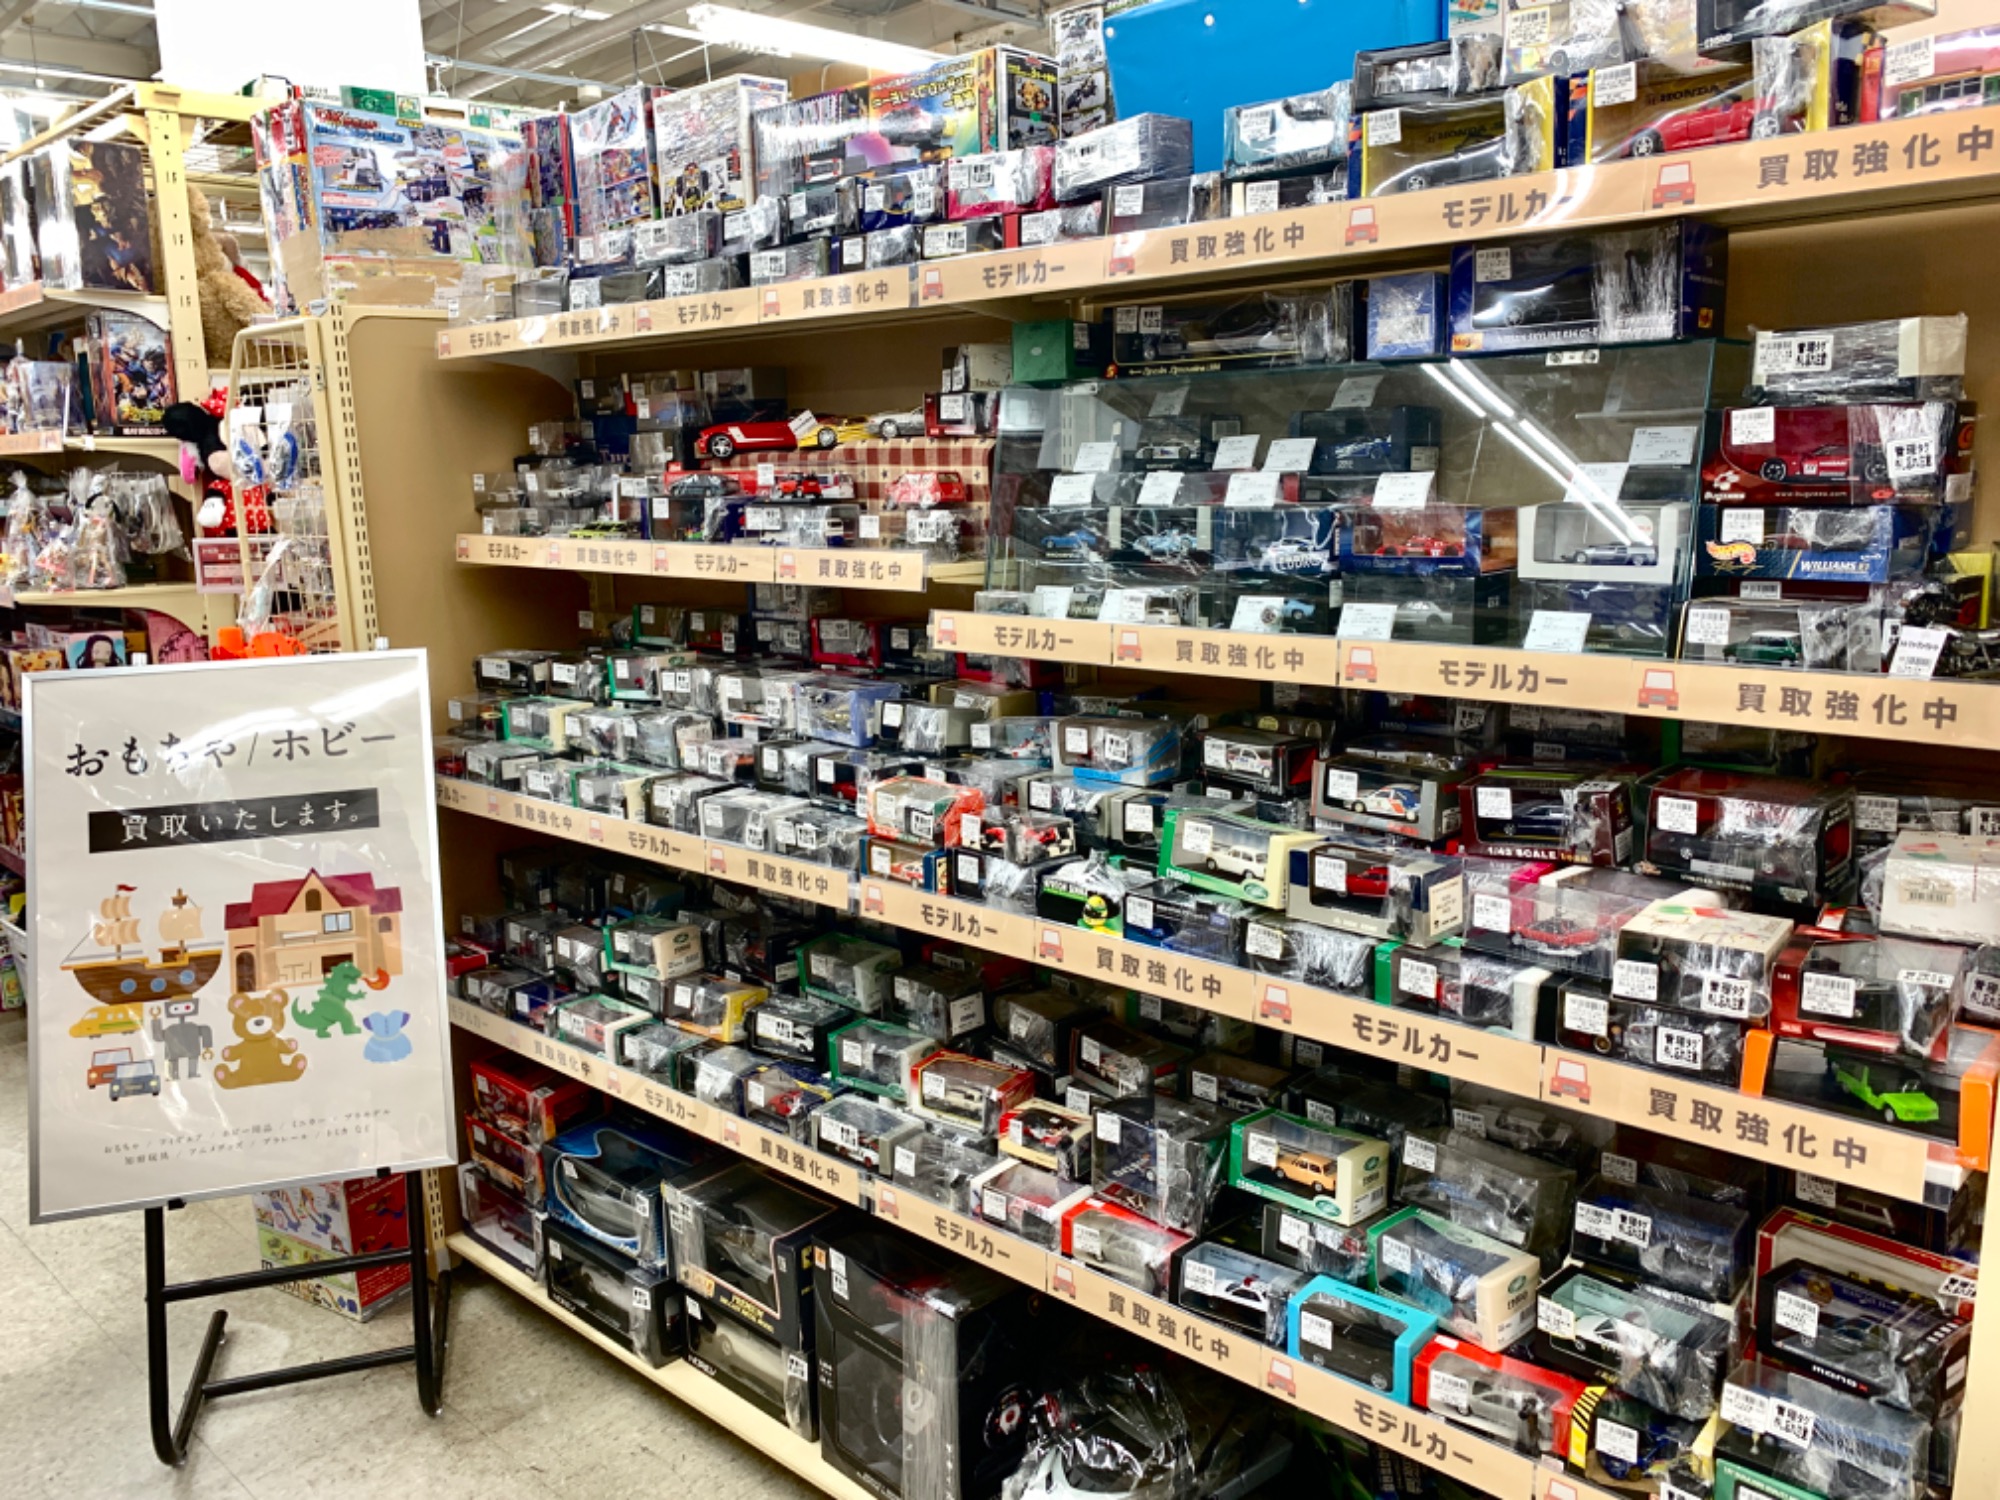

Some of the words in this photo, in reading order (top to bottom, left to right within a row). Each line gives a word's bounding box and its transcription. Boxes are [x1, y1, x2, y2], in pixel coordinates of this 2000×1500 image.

[1756, 124, 1996, 190] 買取強化中
[1169, 221, 1306, 265] 買取強化中
[982, 258, 1066, 289] モデルカー
[802, 281, 890, 309] 買取強化中
[677, 301, 734, 325] モデルカー
[470, 331, 511, 350] モデルカー
[487, 542, 529, 560] モデルカー
[576, 547, 638, 567] 買取強化中
[693, 553, 750, 574] モデルカー
[818, 558, 903, 581] 買取強化中
[993, 625, 1074, 652] モデルカー
[1175, 639, 1305, 672] 買取強化中
[1438, 660, 1568, 694] モデルカー
[1737, 683, 1958, 730] 買取強化中
[121, 799, 361, 842] 買取いたします。
[513, 803, 573, 832] 買取強化中
[627, 830, 682, 856] モデルカー
[1515, 848, 1557, 861] SCALE
[746, 858, 829, 895] 買取強化中
[920, 903, 999, 938] モデルカー
[1096, 946, 1222, 999] 買取強化中
[1351, 1012, 1480, 1065] モデルカー
[533, 1040, 592, 1078] 買取強化中
[643, 1086, 698, 1121] モデルカー
[1648, 1088, 1868, 1170] 買取強化中
[760, 1137, 841, 1186] 買取強化中
[933, 1215, 1011, 1262] モデルカー
[1109, 1291, 1230, 1361] 買取強化中
[1353, 1399, 1474, 1465] モデルカー
